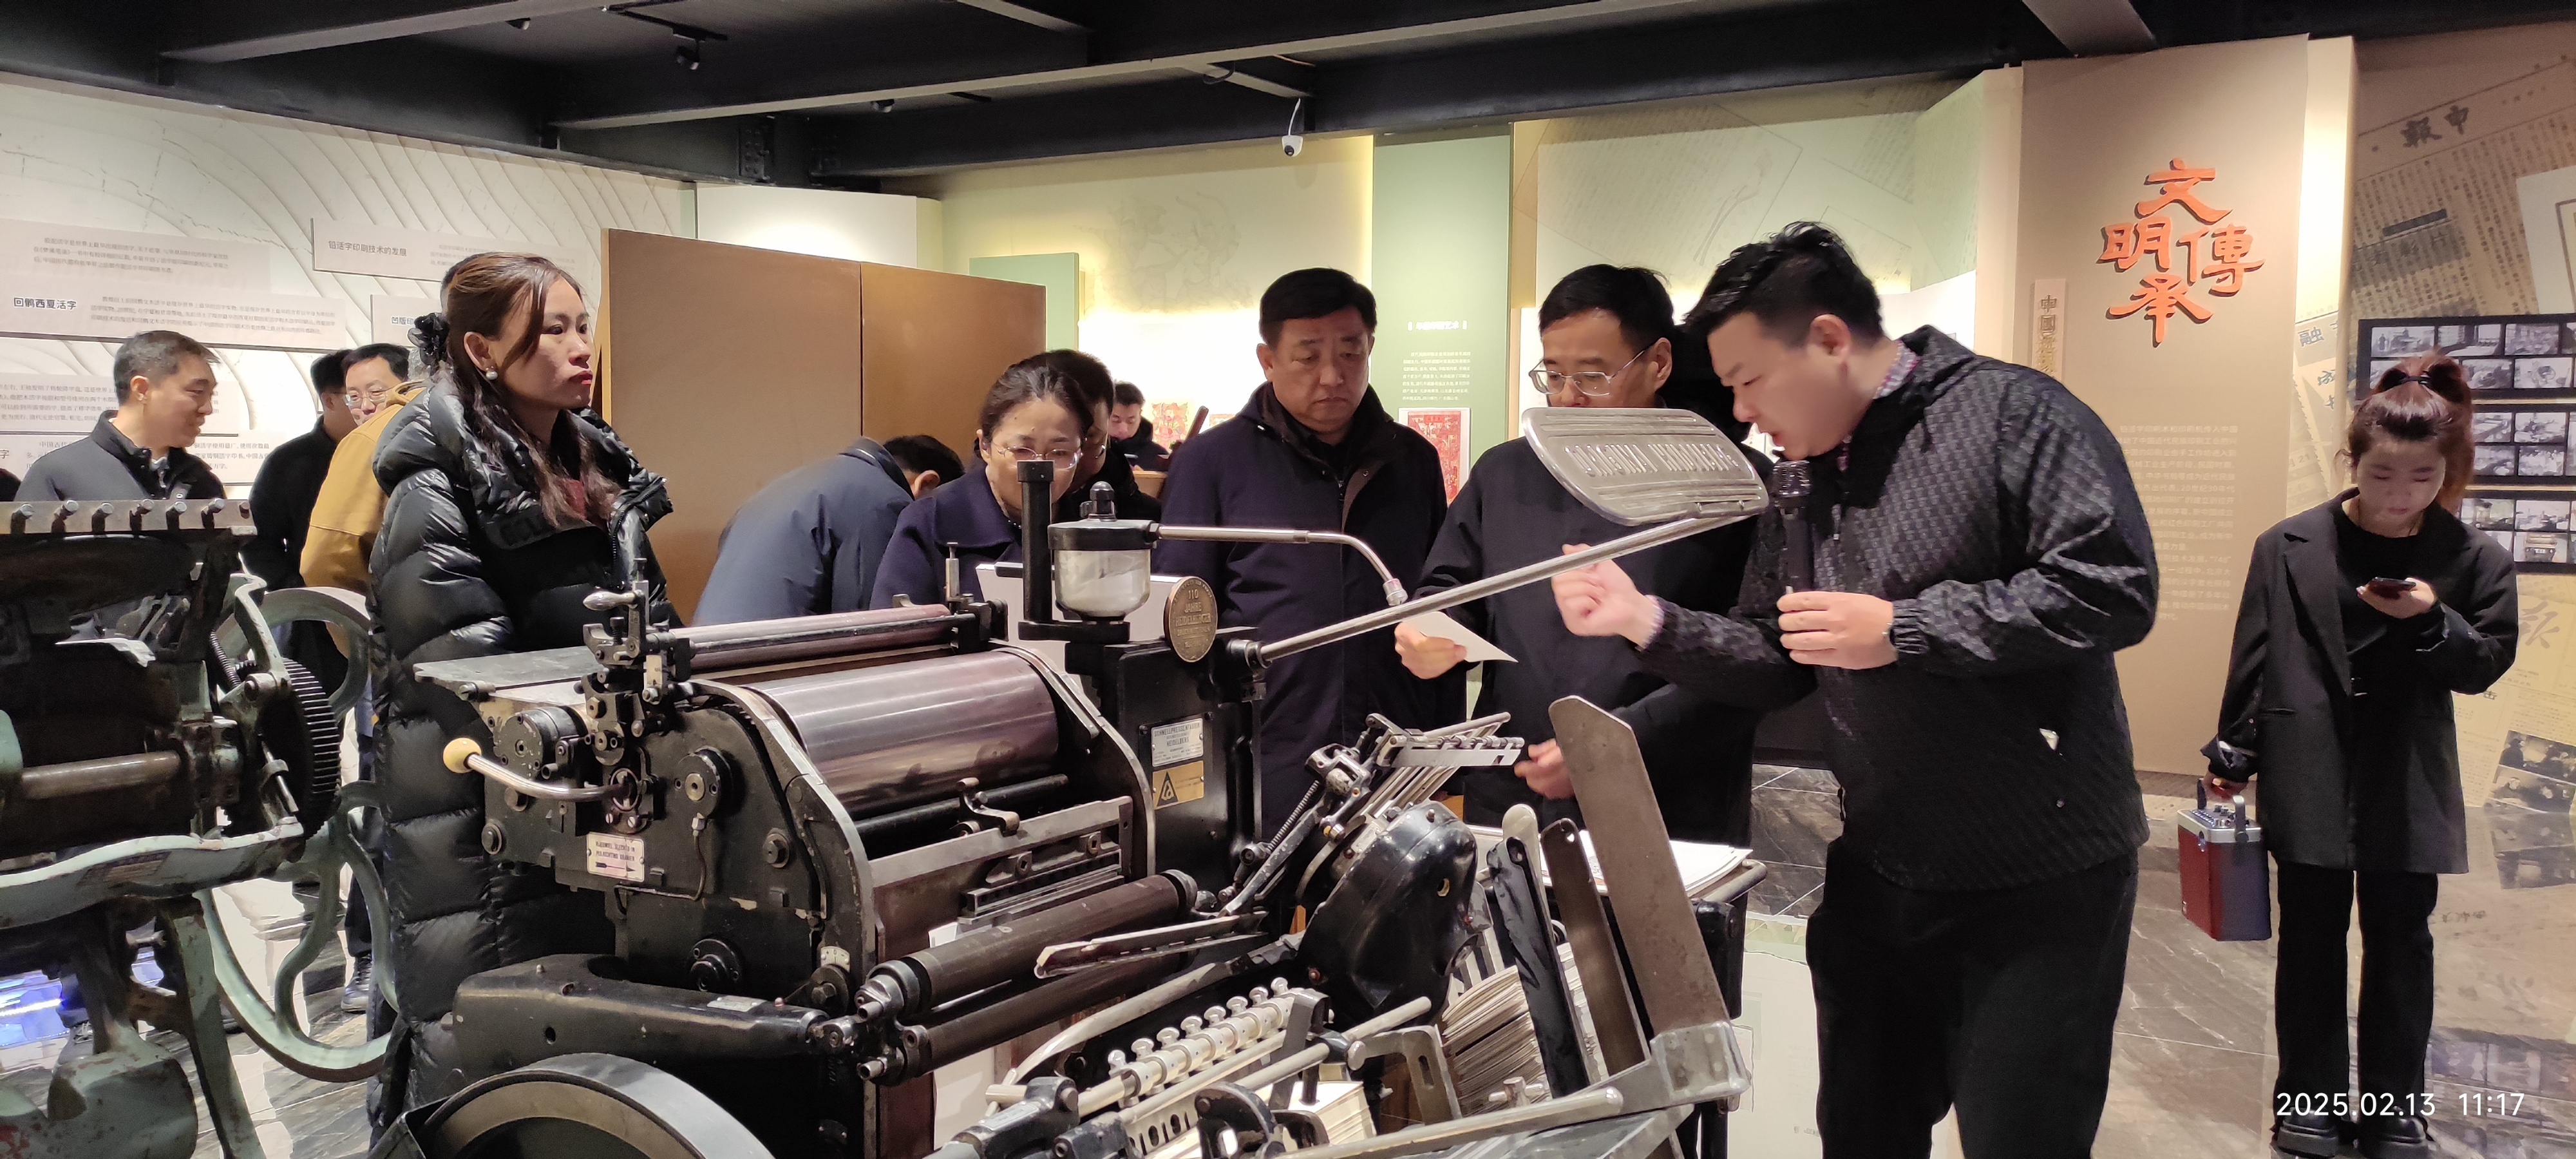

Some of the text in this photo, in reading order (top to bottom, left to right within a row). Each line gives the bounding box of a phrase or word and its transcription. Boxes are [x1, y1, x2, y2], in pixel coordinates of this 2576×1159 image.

[14, 297, 77, 310] 回鹘西夏活字
[1188, 589, 1198, 599] 110
[1184, 602, 1202, 613] JAHRE
